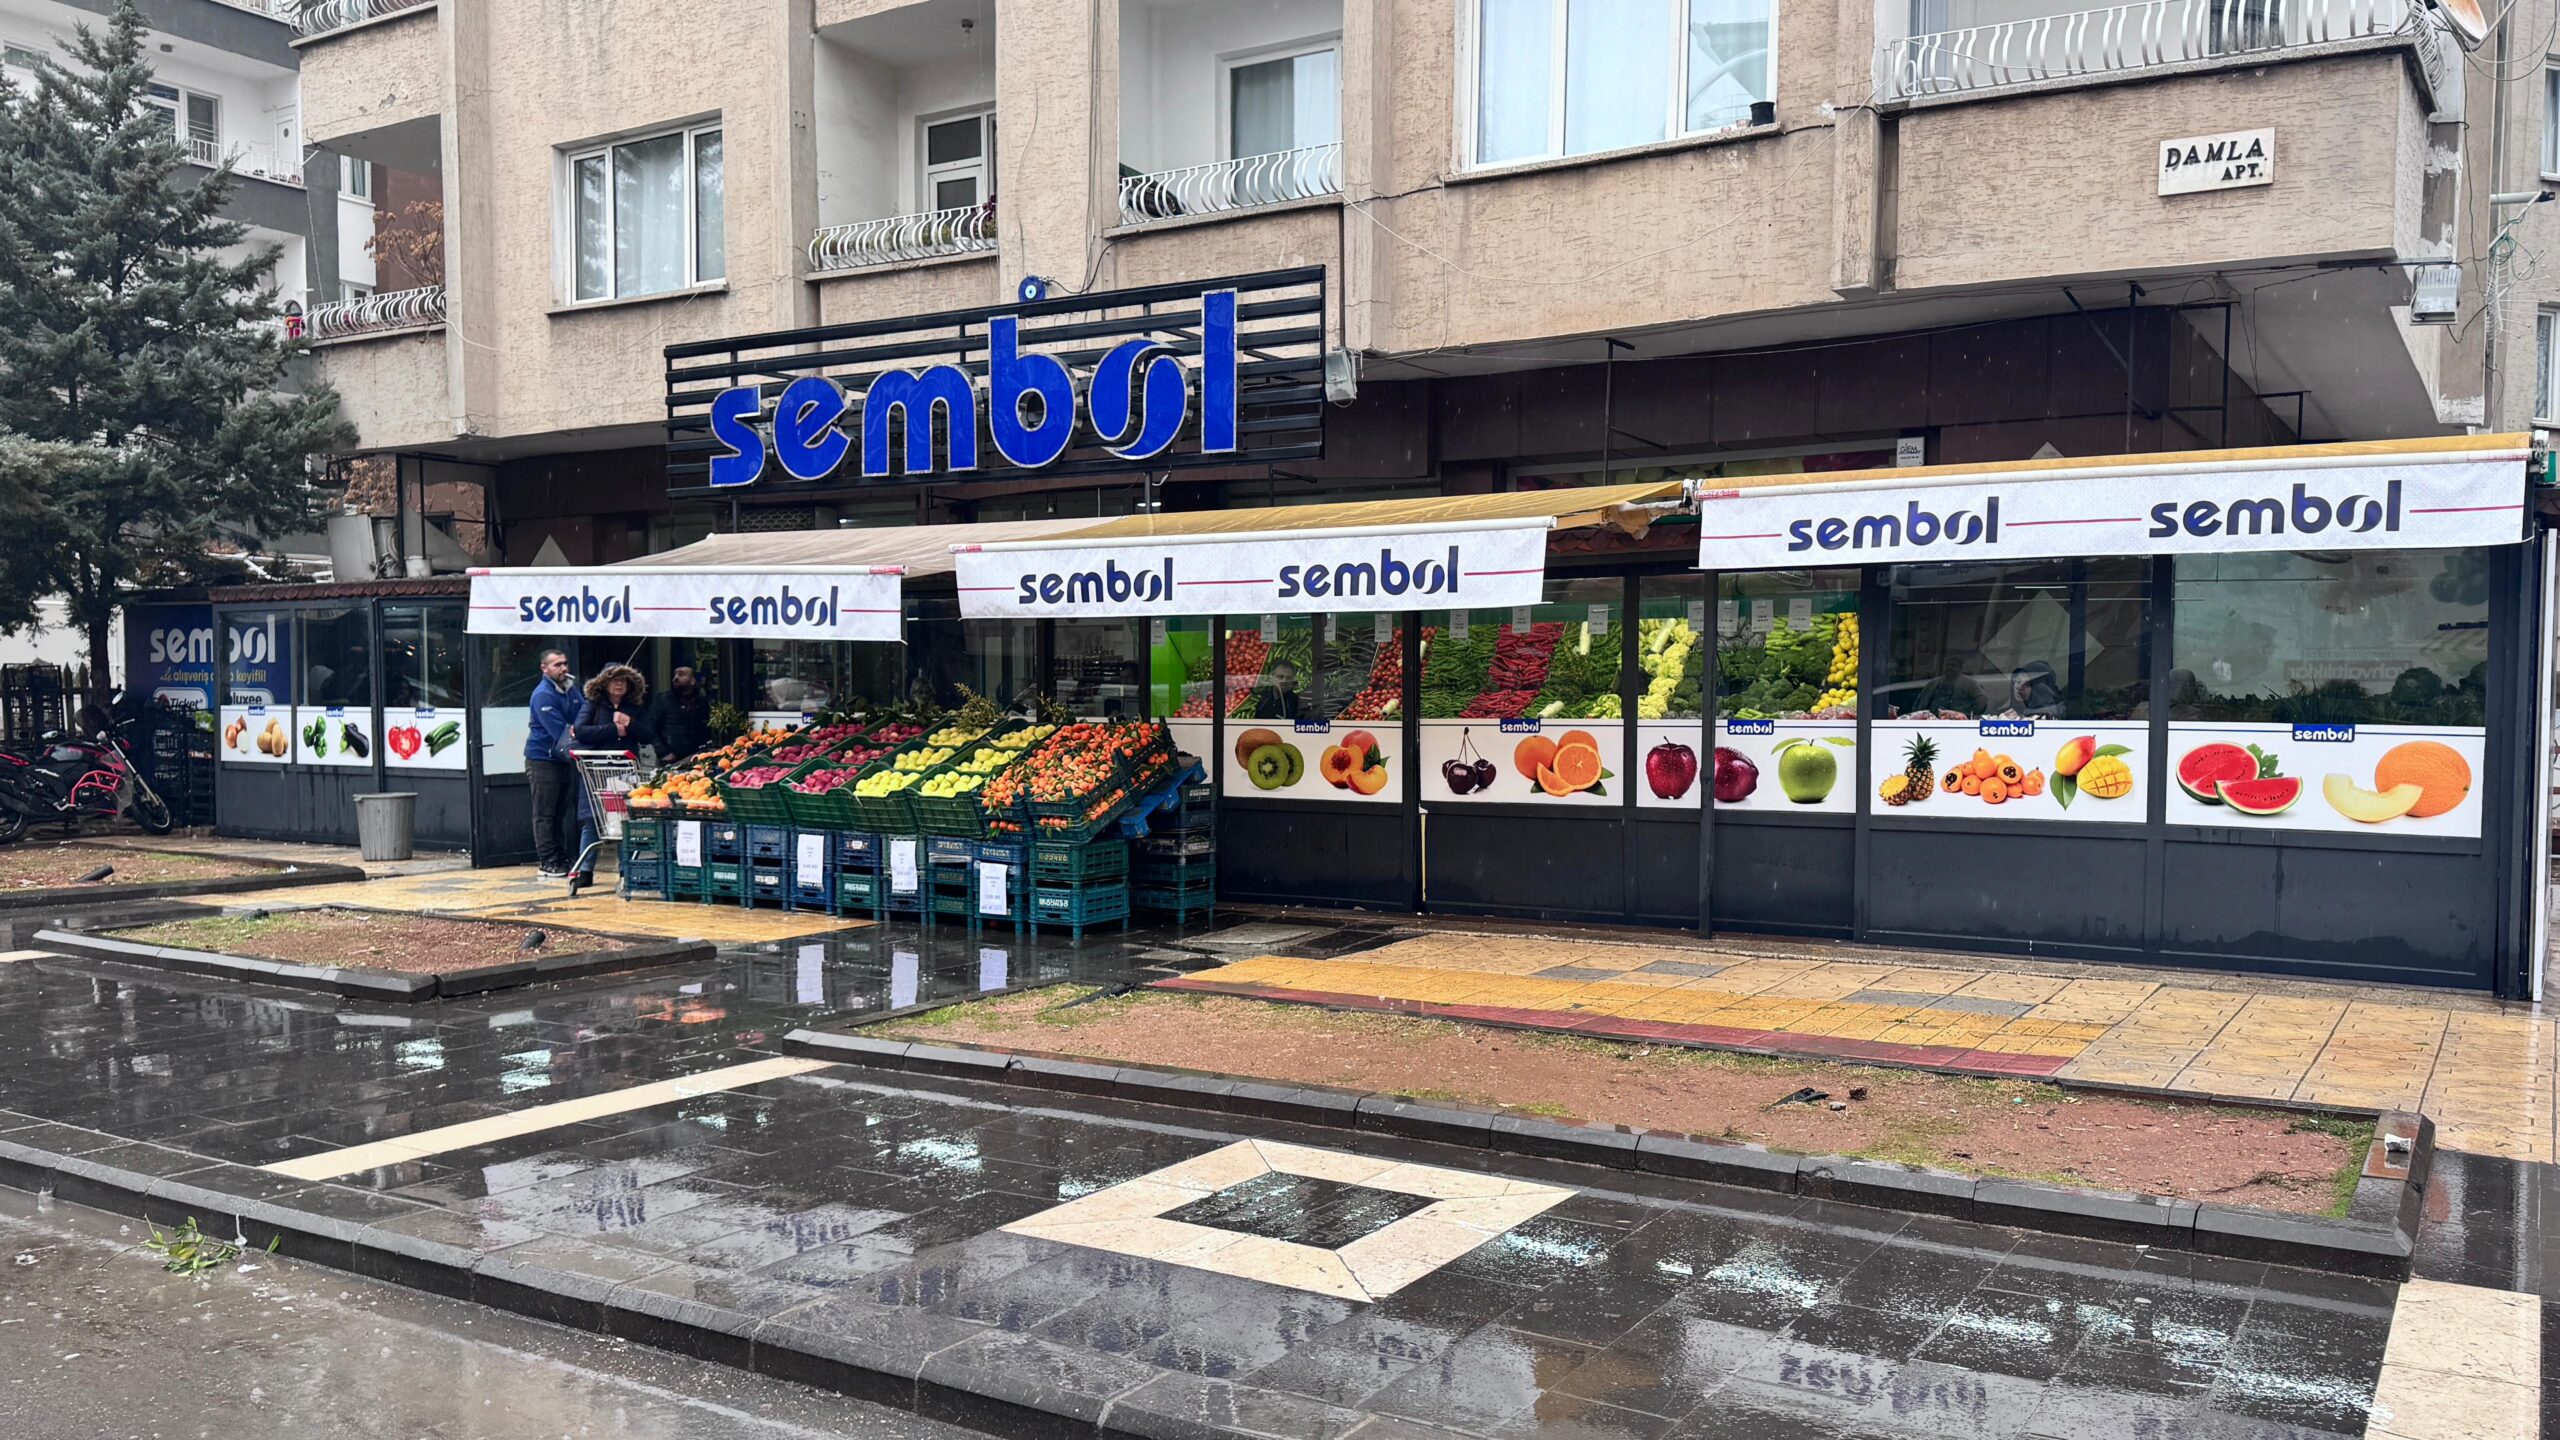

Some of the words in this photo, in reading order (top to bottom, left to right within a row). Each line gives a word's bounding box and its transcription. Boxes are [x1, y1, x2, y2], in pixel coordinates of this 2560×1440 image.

[2165, 138, 2264, 168] DAMLA
[2221, 163, 2264, 180] APT.
[709, 287, 1238, 488] sembol
[1788, 497, 2000, 552] sembol
[2148, 480, 2402, 538] sembol
[1018, 557, 1174, 605] sembol
[1278, 546, 1459, 598] sembol
[520, 585, 631, 624] sembol
[709, 585, 838, 627] sembol
[1295, 722, 1329, 733] sembol
[1501, 721, 1539, 732] sembol
[1729, 722, 1772, 734] sembol
[1981, 723, 2033, 736] sembol
[2294, 727, 2353, 741] sembol
